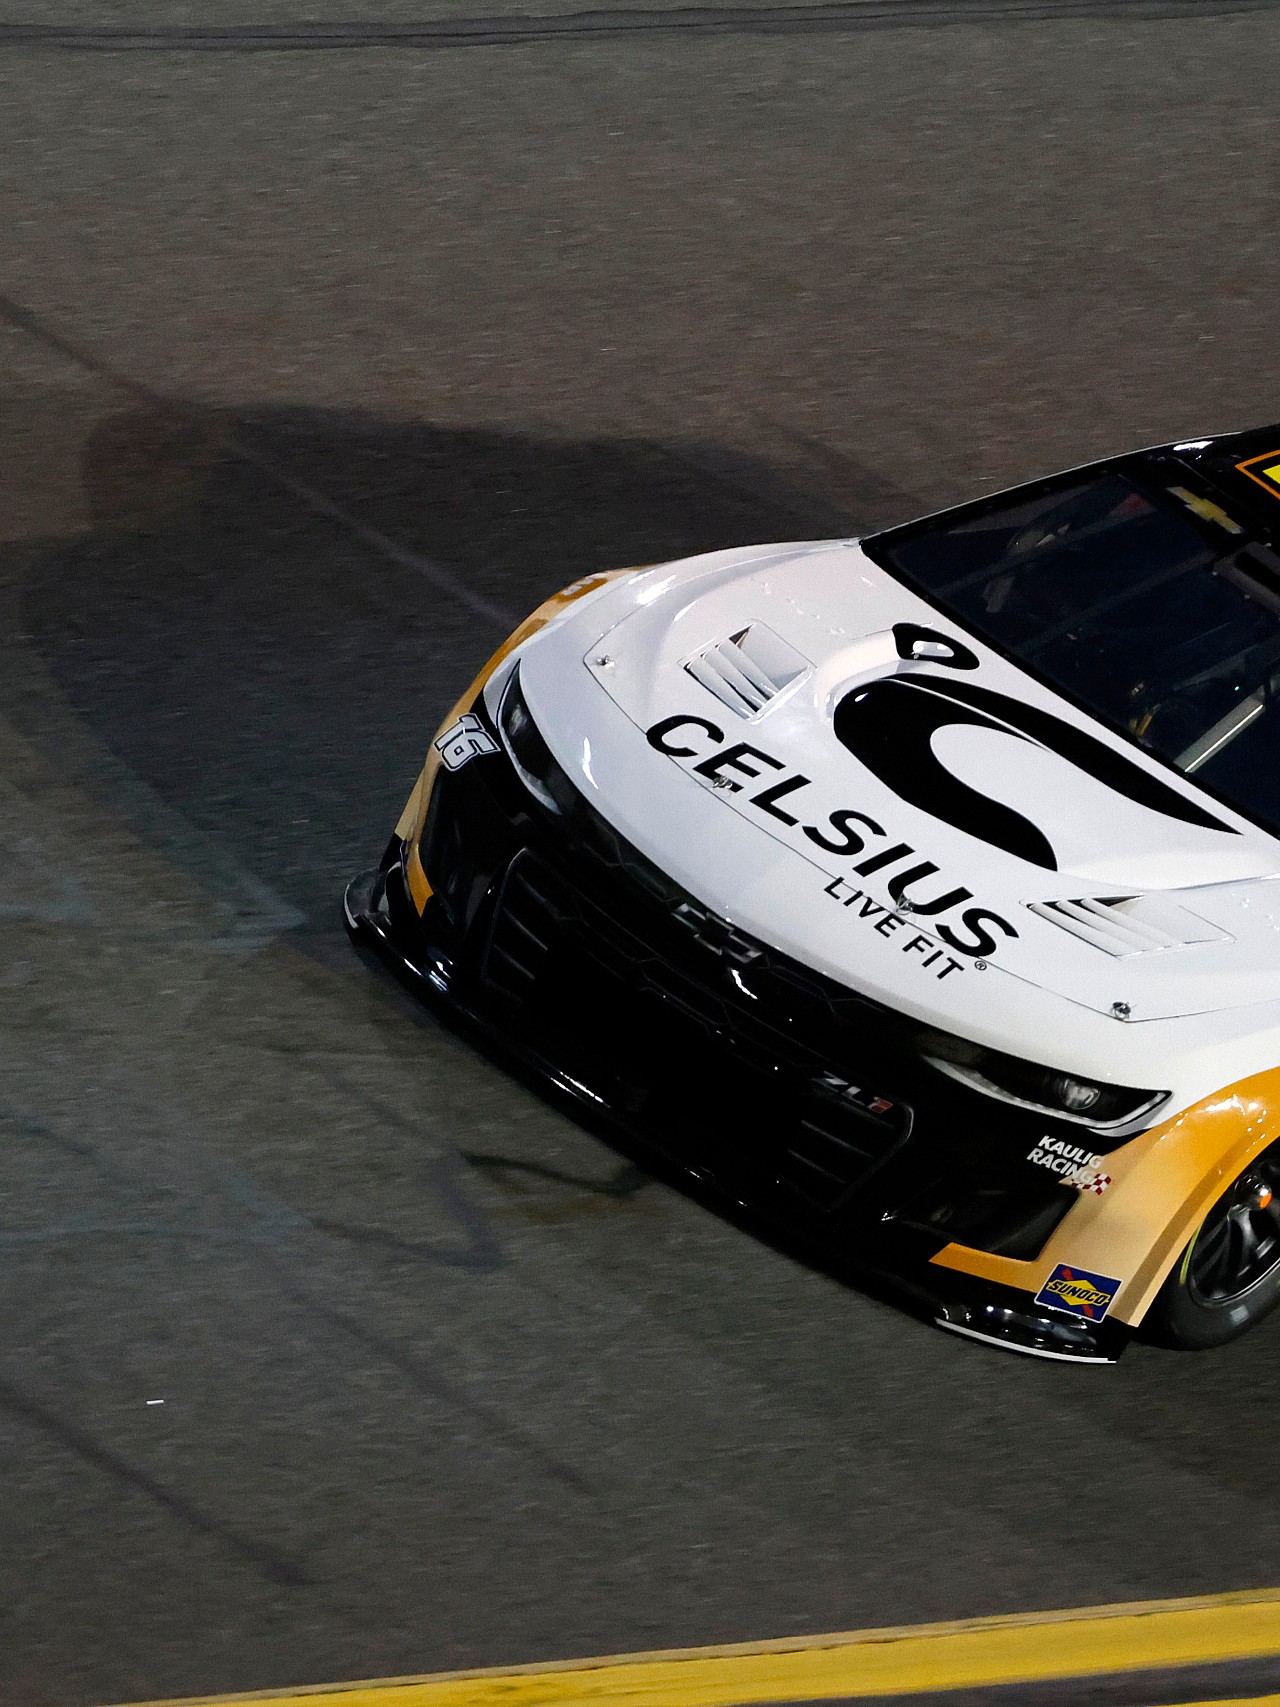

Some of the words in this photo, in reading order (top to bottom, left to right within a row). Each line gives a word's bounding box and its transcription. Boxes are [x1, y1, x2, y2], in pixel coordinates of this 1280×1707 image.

[433, 712, 501, 771] 16
[646, 715, 1020, 957] CELSIUS
[823, 876, 906, 938] LIVE
[902, 935, 965, 980] FIT
[1026, 1147, 1098, 1184] RACING
[1037, 1134, 1104, 1169] KAULIG
[1047, 1280, 1109, 1305] SUNOCO
